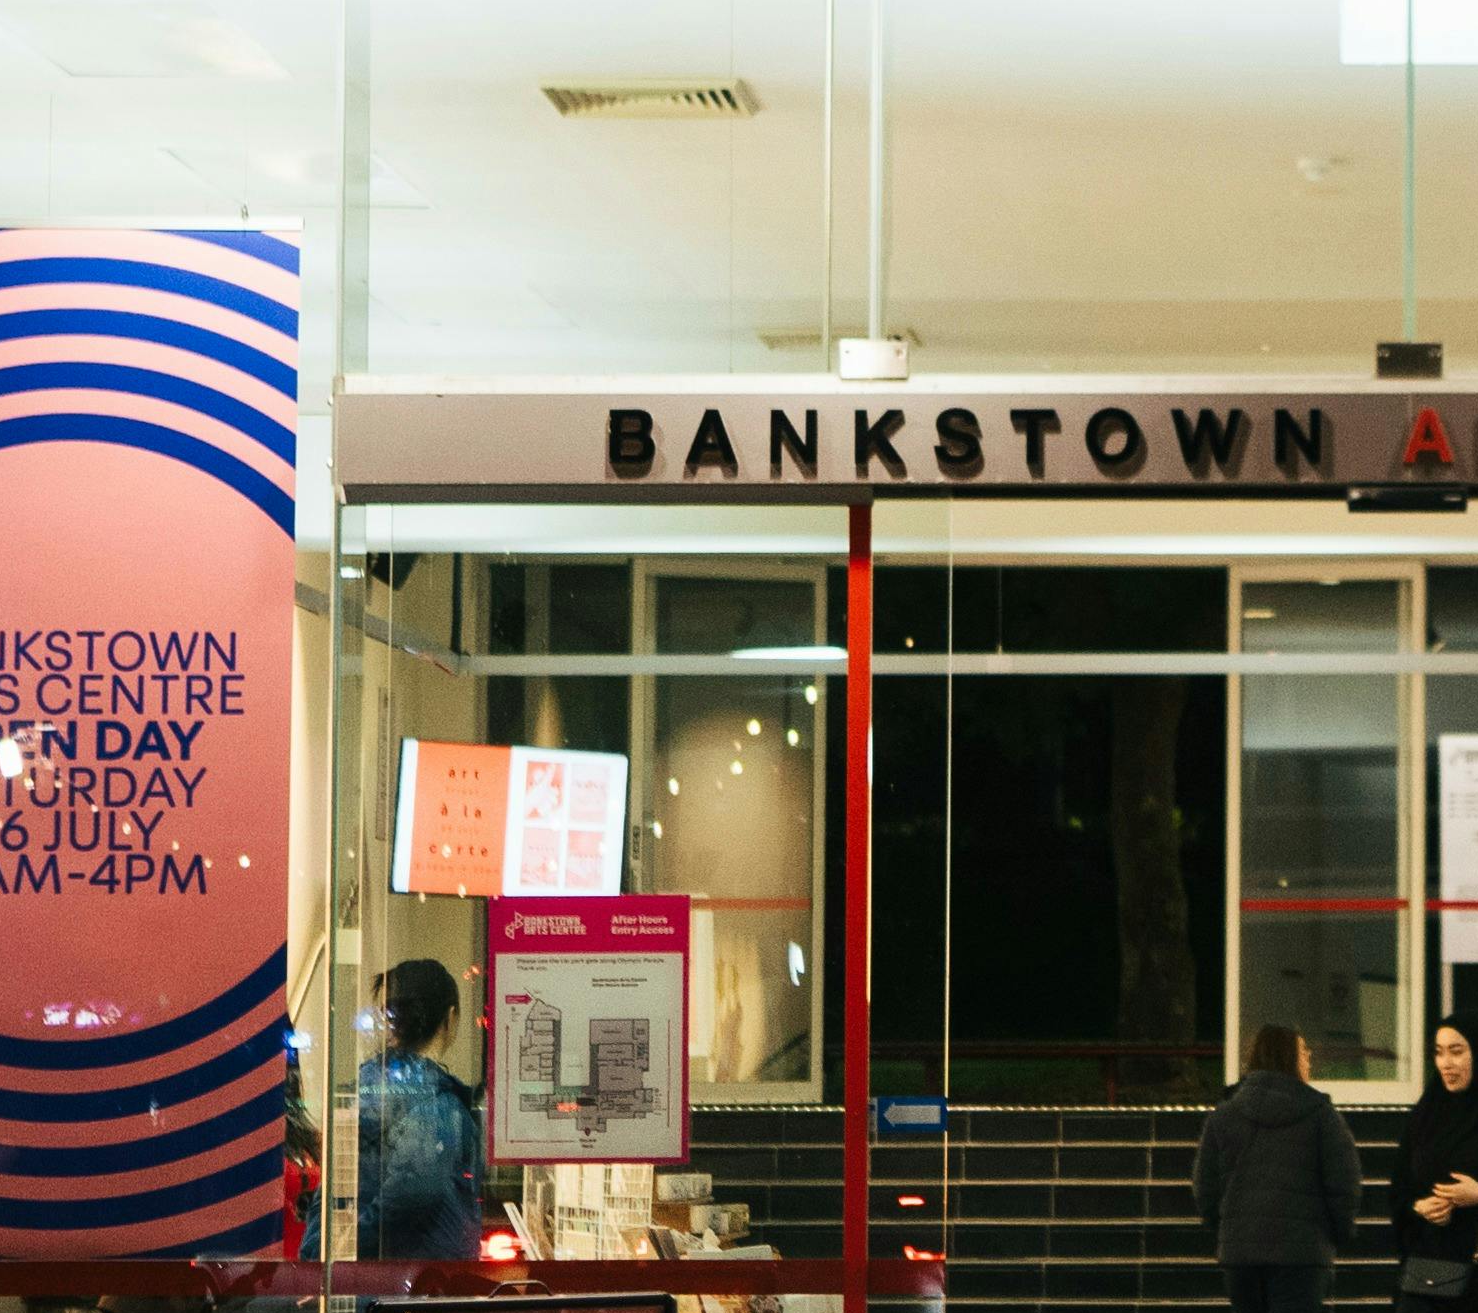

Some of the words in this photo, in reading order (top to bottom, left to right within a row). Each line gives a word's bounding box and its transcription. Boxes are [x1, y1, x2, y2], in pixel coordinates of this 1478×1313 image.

[607, 406, 1328, 476] BANKSTOWN
[35, 674, 245, 715] CENTRE
[95, 720, 205, 761] DAY
[448, 768, 480, 781] art
[463, 804, 482, 819] la
[43, 811, 165, 852] JULY
[428, 844, 489, 858] crte
[610, 915, 637, 926] After
[639, 915, 669, 926] Hours
[610, 925, 638, 937] Entry
[639, 925, 675, 935] Access
